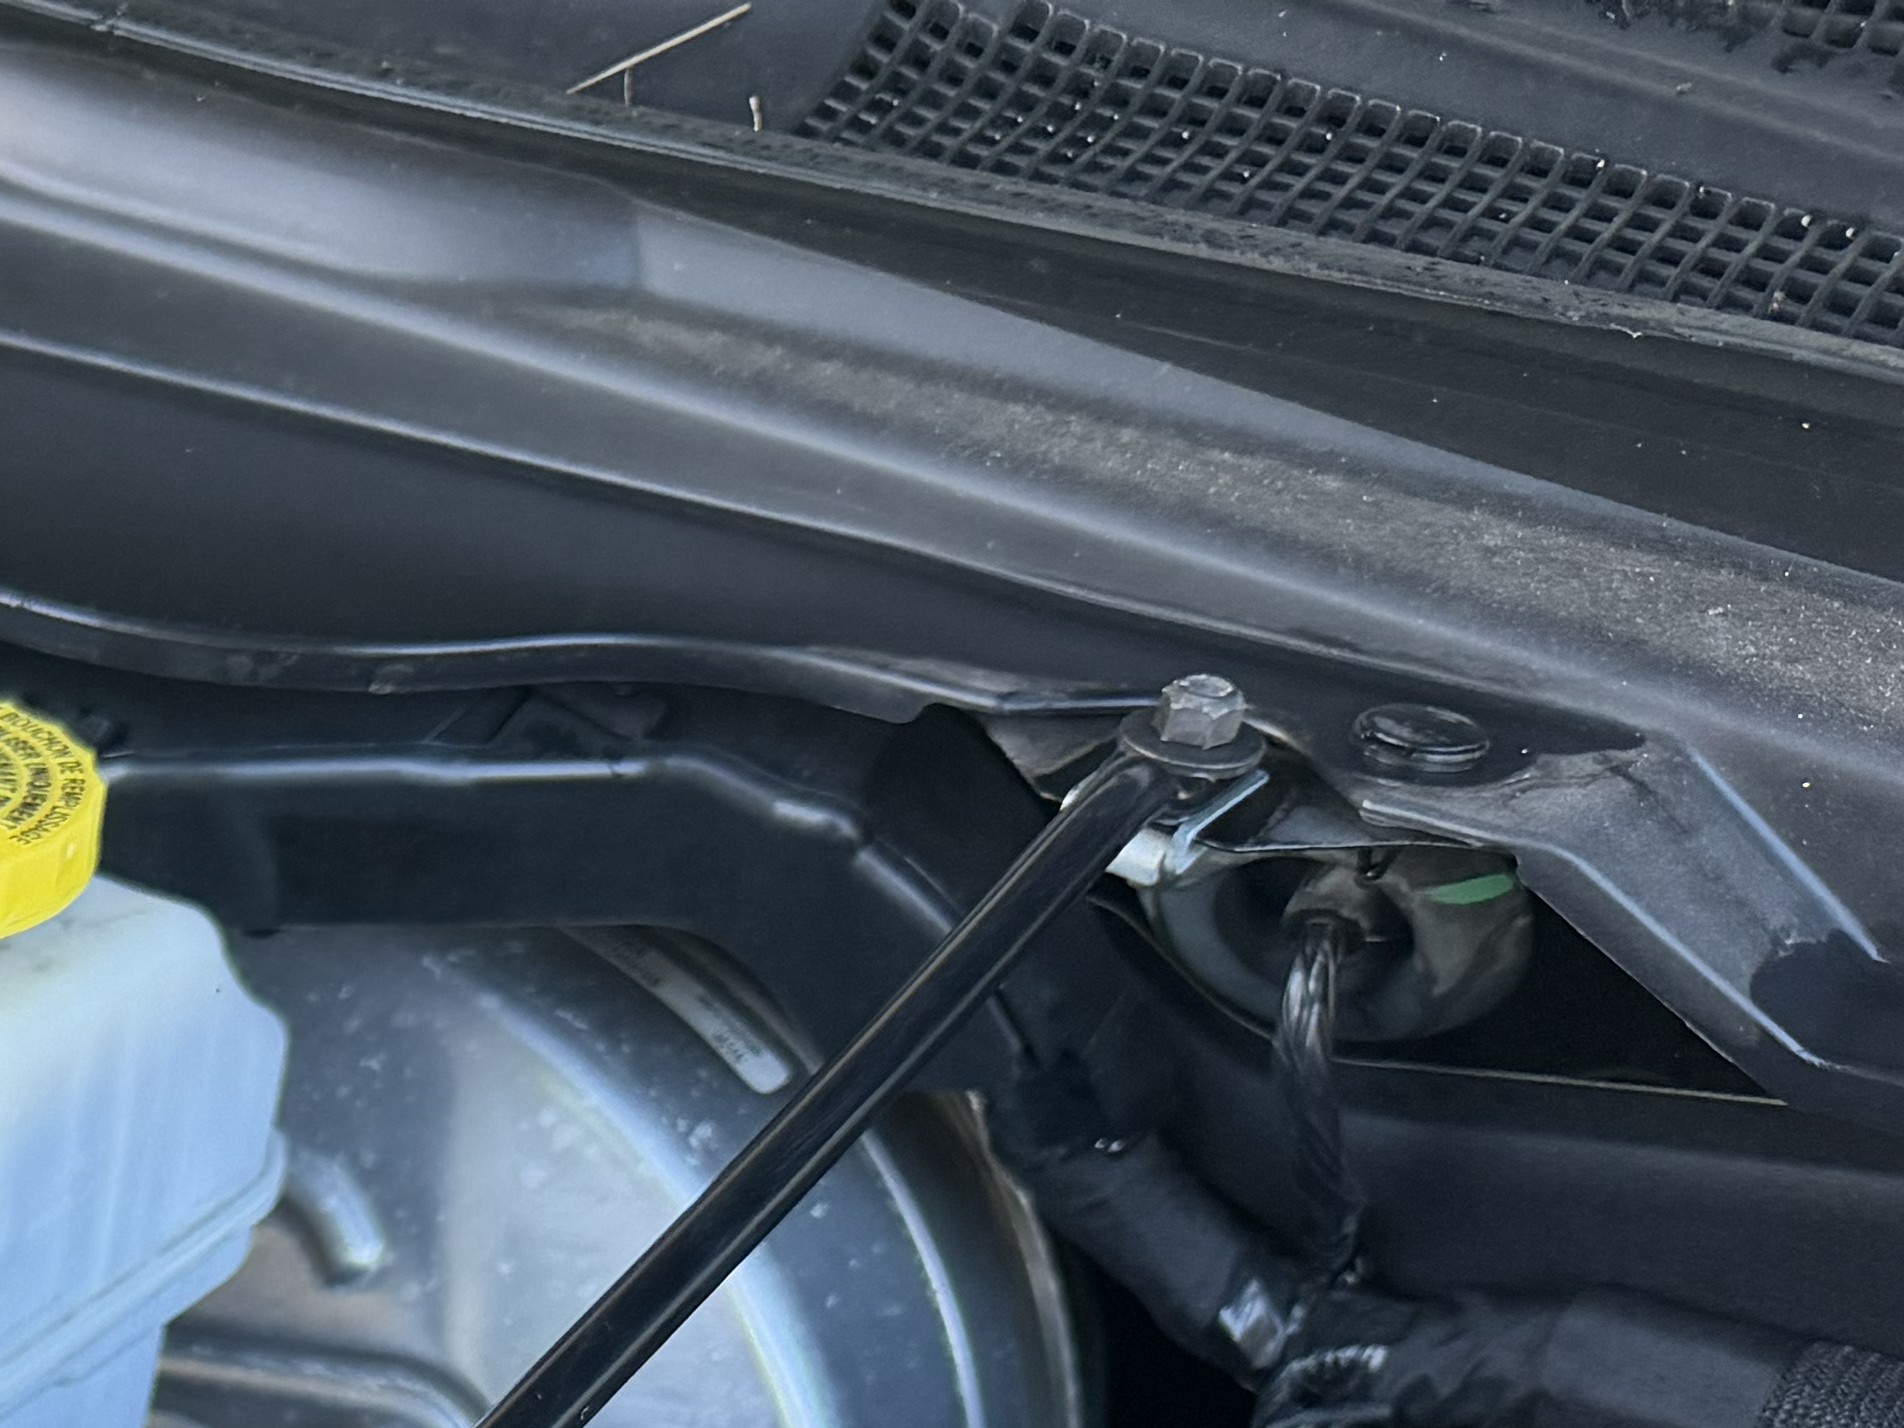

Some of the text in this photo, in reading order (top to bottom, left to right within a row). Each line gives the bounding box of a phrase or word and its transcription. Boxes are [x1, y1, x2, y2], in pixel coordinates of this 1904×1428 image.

[1, 712, 73, 759] BOUCHON
[57, 759, 84, 775] DE
[8, 777, 86, 845] REMPLISSAGE
